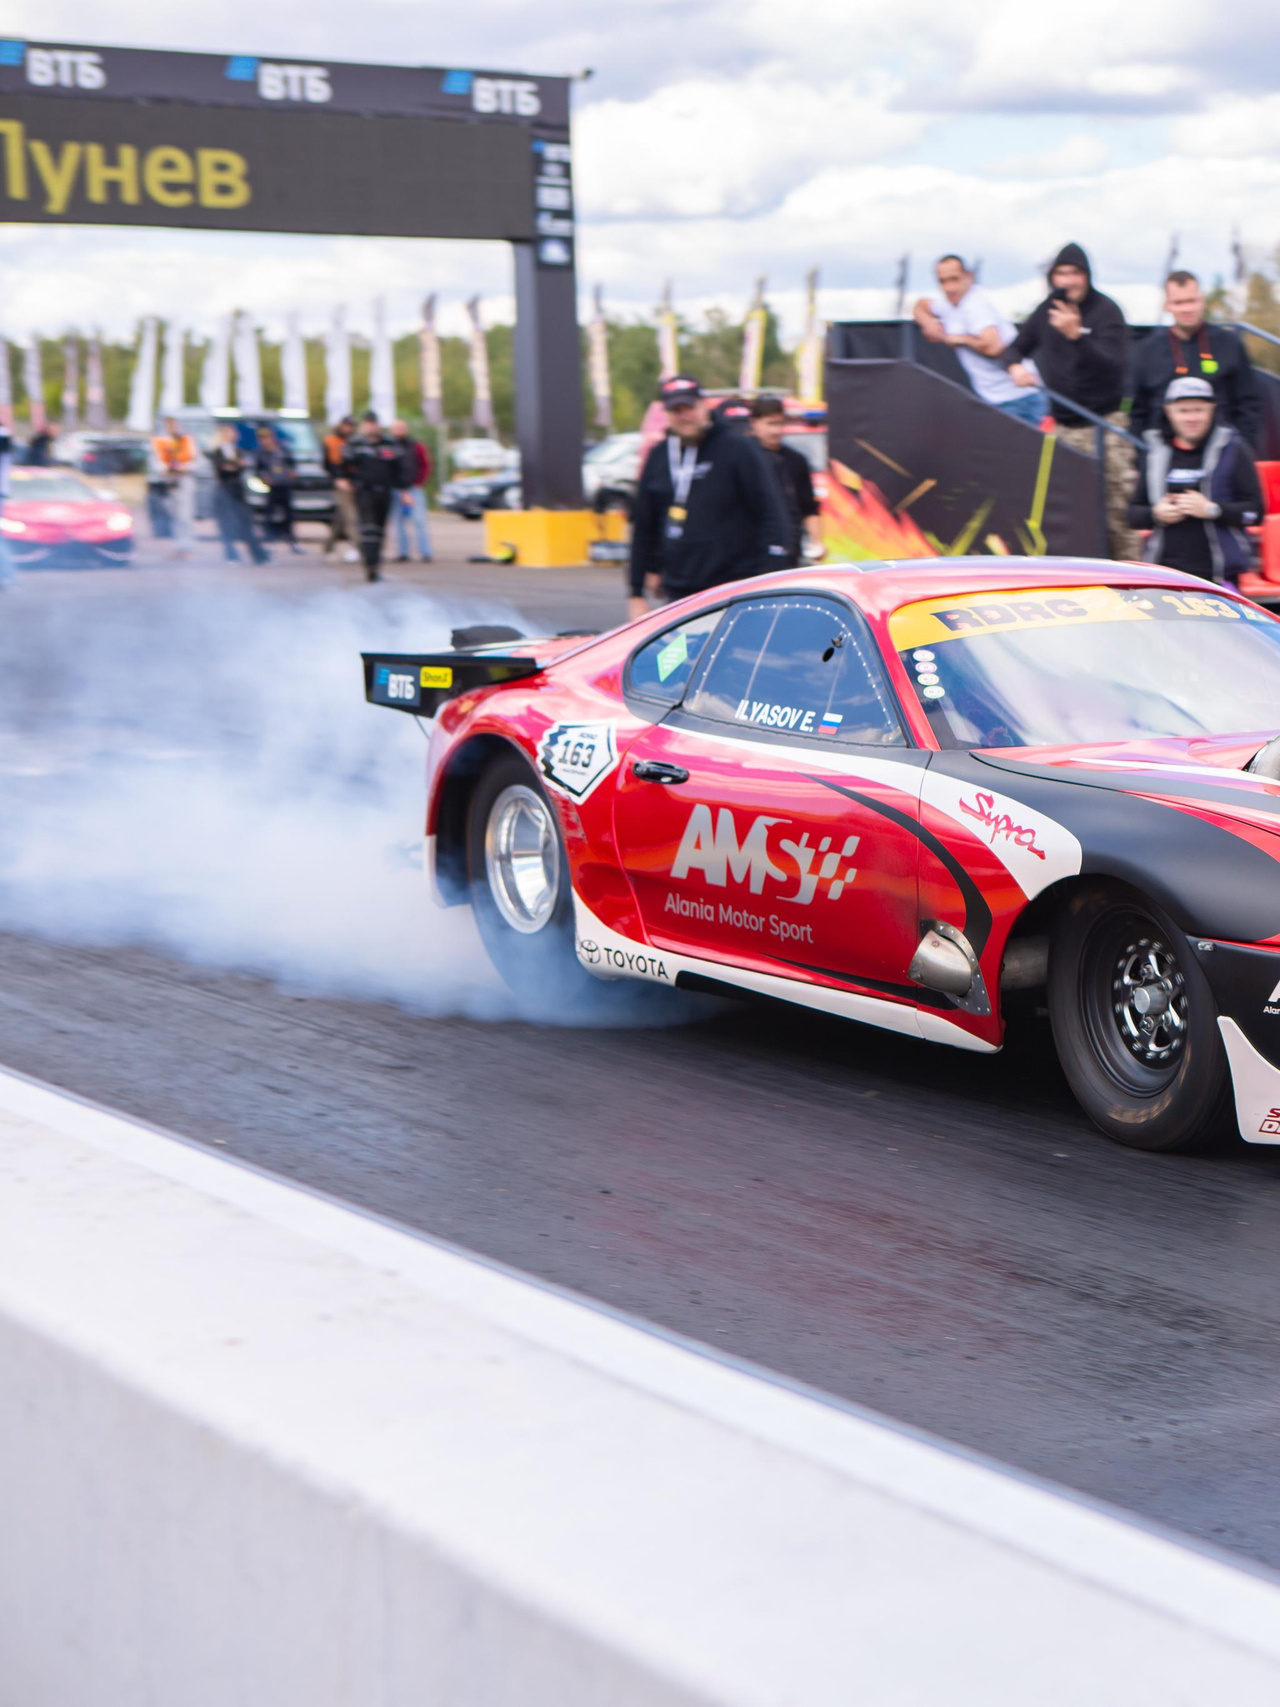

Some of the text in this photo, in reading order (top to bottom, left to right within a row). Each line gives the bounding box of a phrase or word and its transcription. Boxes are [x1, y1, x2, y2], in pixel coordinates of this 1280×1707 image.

[26, 48, 107, 89] ВТБ
[257, 63, 332, 103] ВТБ
[471, 77, 541, 116] ВТБ
[929, 599, 1088, 631] RDRC
[1162, 595, 1240, 618] 163
[388, 673, 415, 700] ВТБ
[734, 699, 816, 732] ILYASOV E.
[558, 740, 595, 768] 163
[959, 792, 1046, 860] Supra
[664, 893, 814, 944] Alania Motor Sport
[604, 947, 669, 979] TOYOTA
